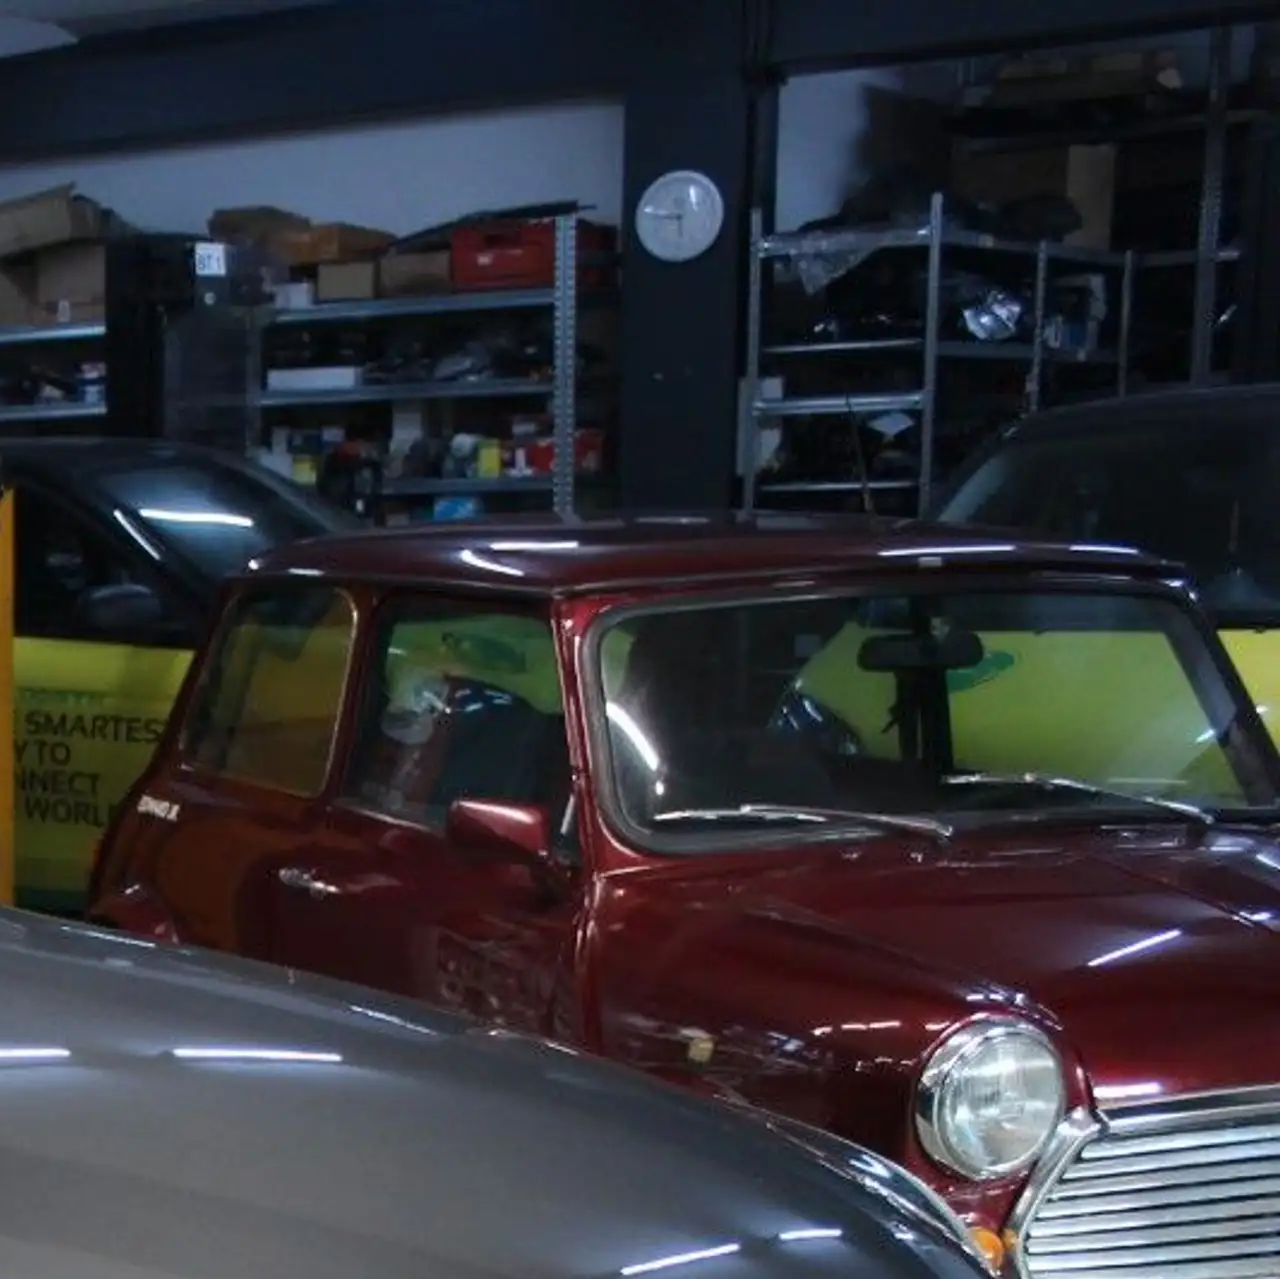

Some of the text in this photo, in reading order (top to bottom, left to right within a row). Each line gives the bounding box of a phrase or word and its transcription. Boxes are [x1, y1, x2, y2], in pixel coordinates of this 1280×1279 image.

[24, 709, 165, 743] SMARTES
[34, 738, 71, 766] TO
[13, 768, 100, 796] NNECT
